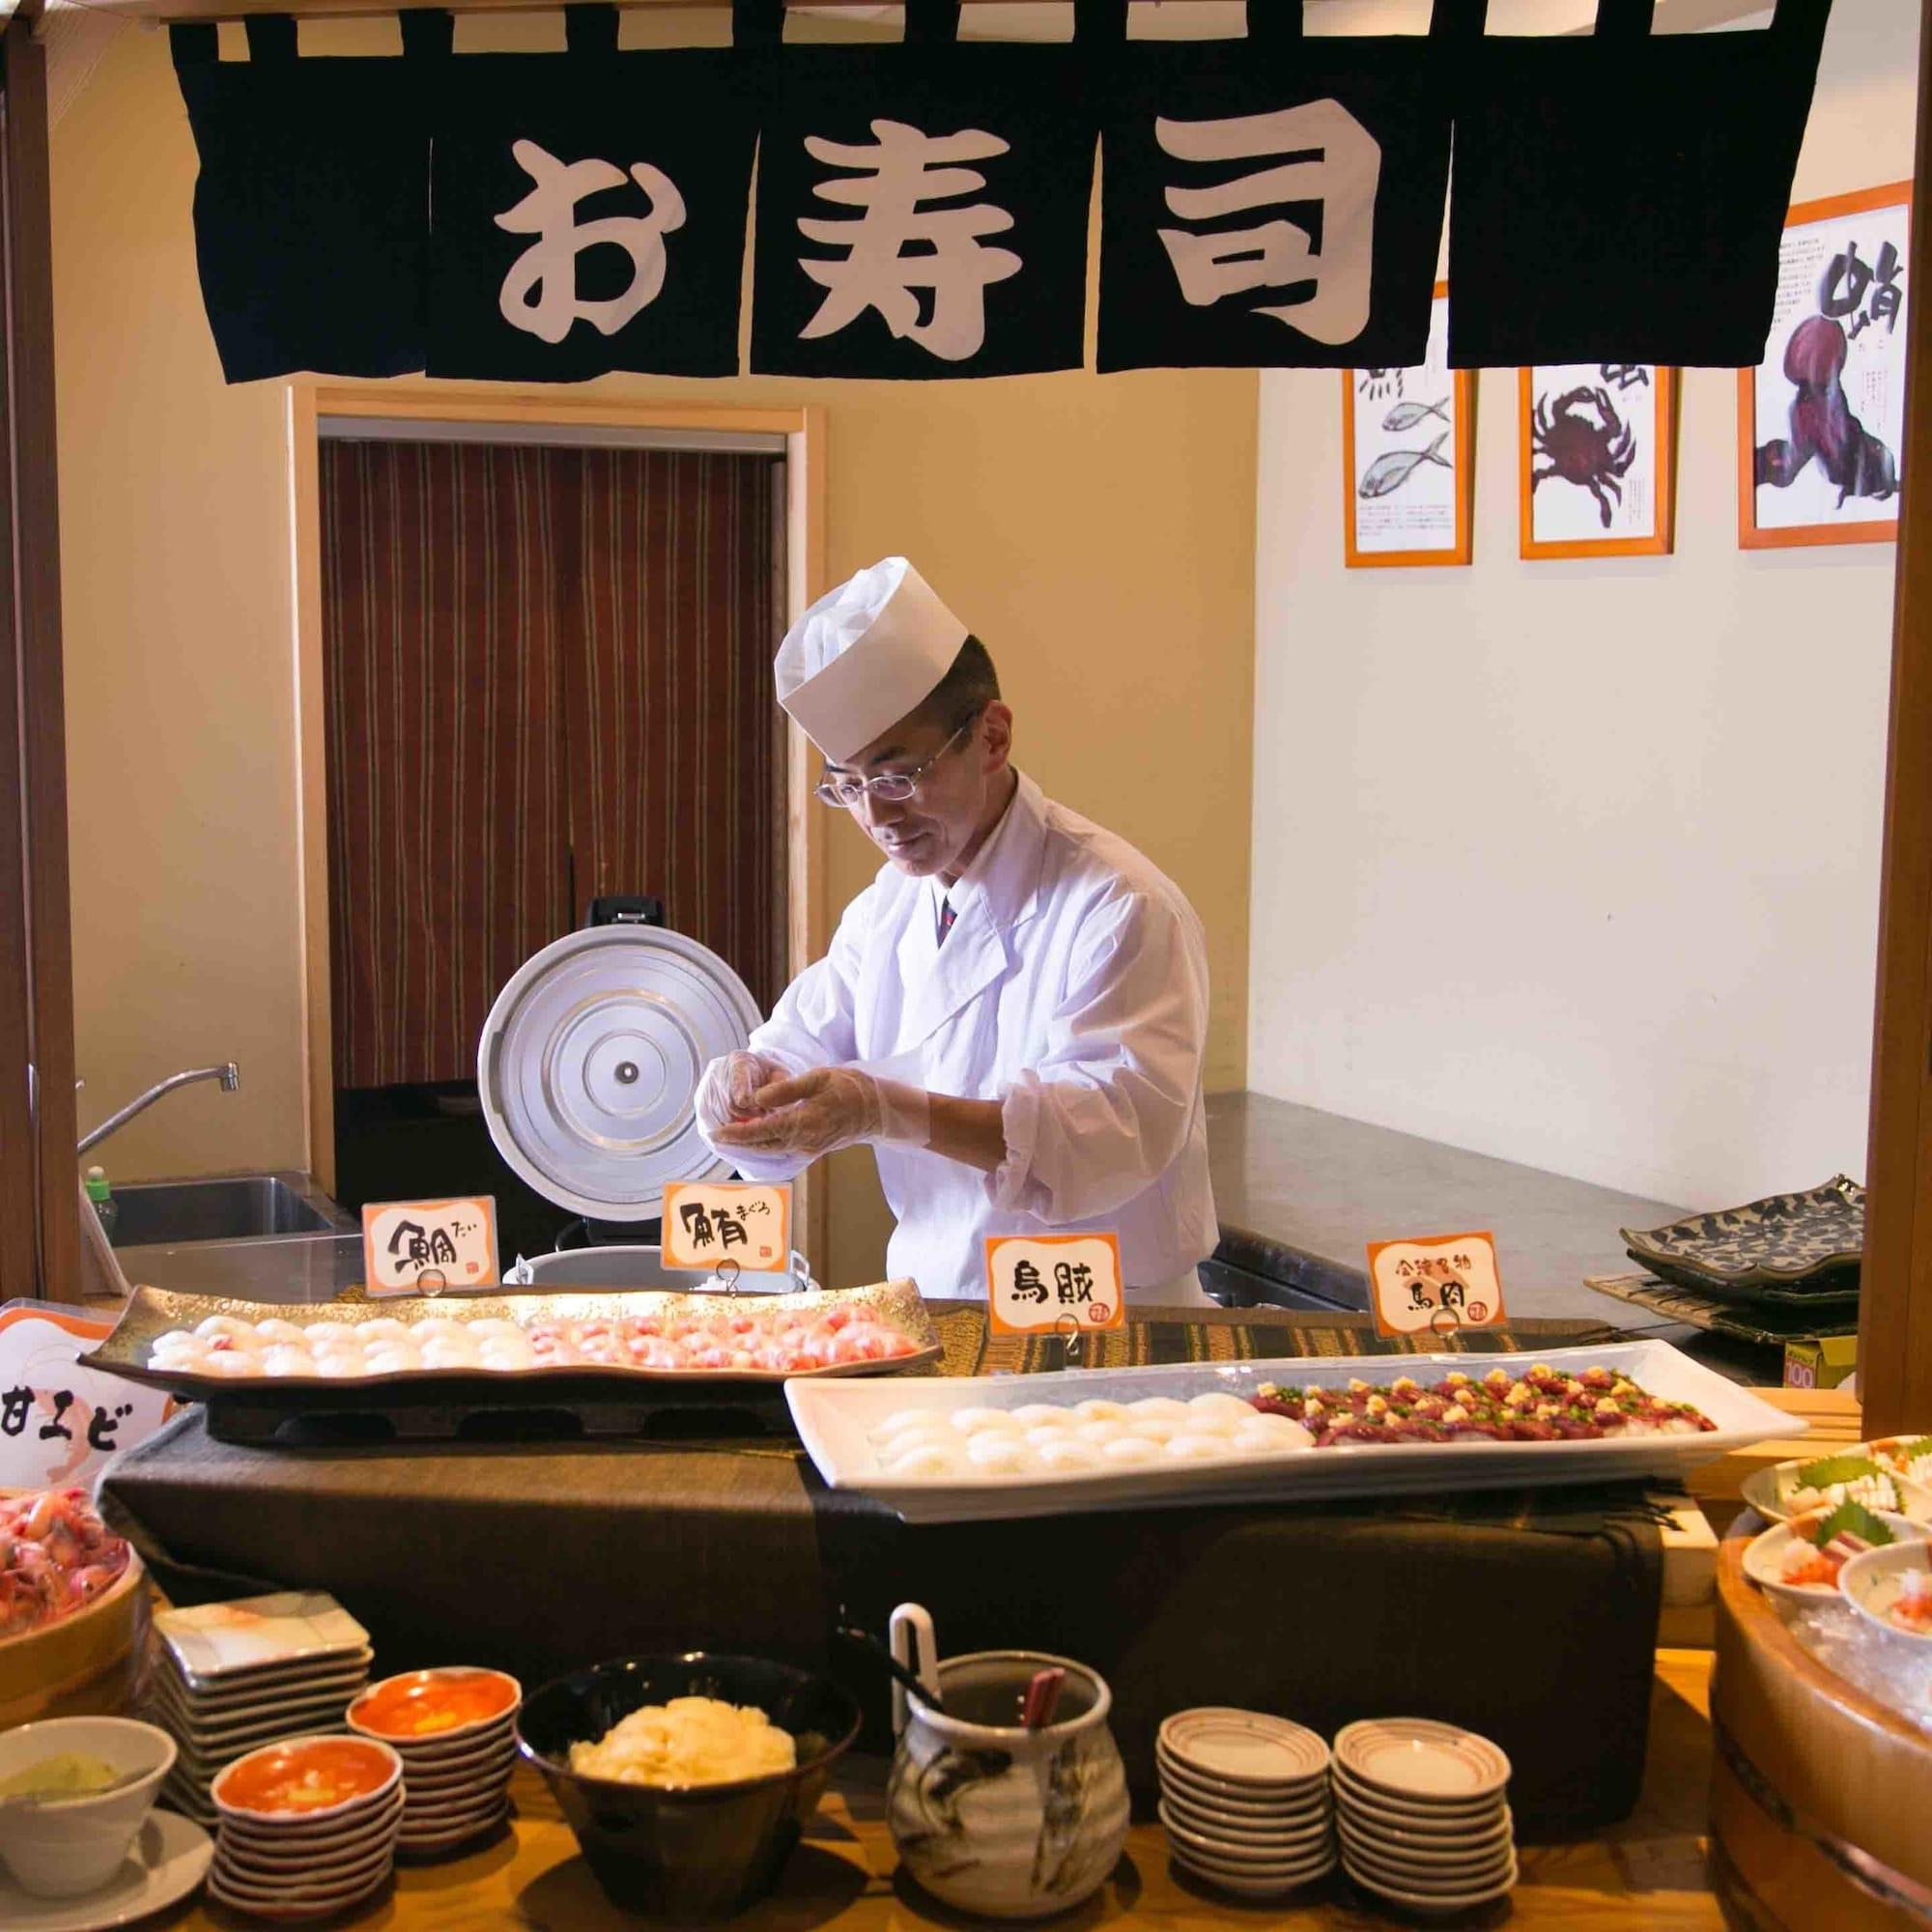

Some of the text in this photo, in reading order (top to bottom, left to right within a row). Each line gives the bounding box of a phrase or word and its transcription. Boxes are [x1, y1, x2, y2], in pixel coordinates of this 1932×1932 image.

[494, 98, 1381, 361] お寿司
[1820, 241, 1904, 340] 蛸
[451, 1221, 477, 1237] たい
[680, 1203, 748, 1250] 鮪
[736, 1201, 771, 1221] まぐろ
[387, 1219, 457, 1273] 鯛
[1407, 1281, 1464, 1311] 馬肉
[1, 1385, 133, 1452] 甘エビ
